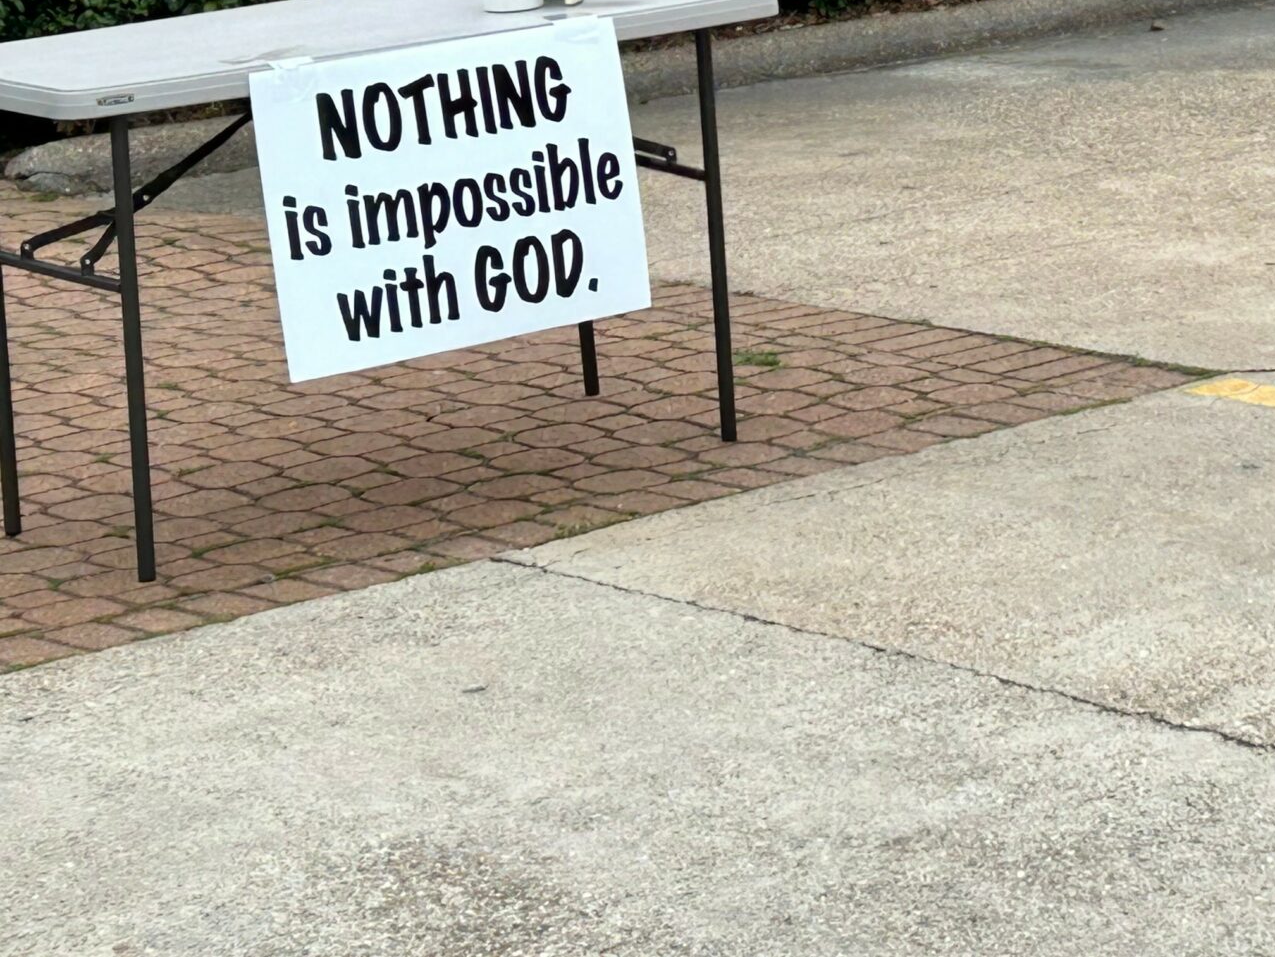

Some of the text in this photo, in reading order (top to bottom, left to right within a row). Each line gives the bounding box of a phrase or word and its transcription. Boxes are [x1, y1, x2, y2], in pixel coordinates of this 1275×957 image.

[316, 56, 571, 161] NOTHING
[282, 137, 624, 260] is impossible
[337, 229, 599, 341] with GOD.
